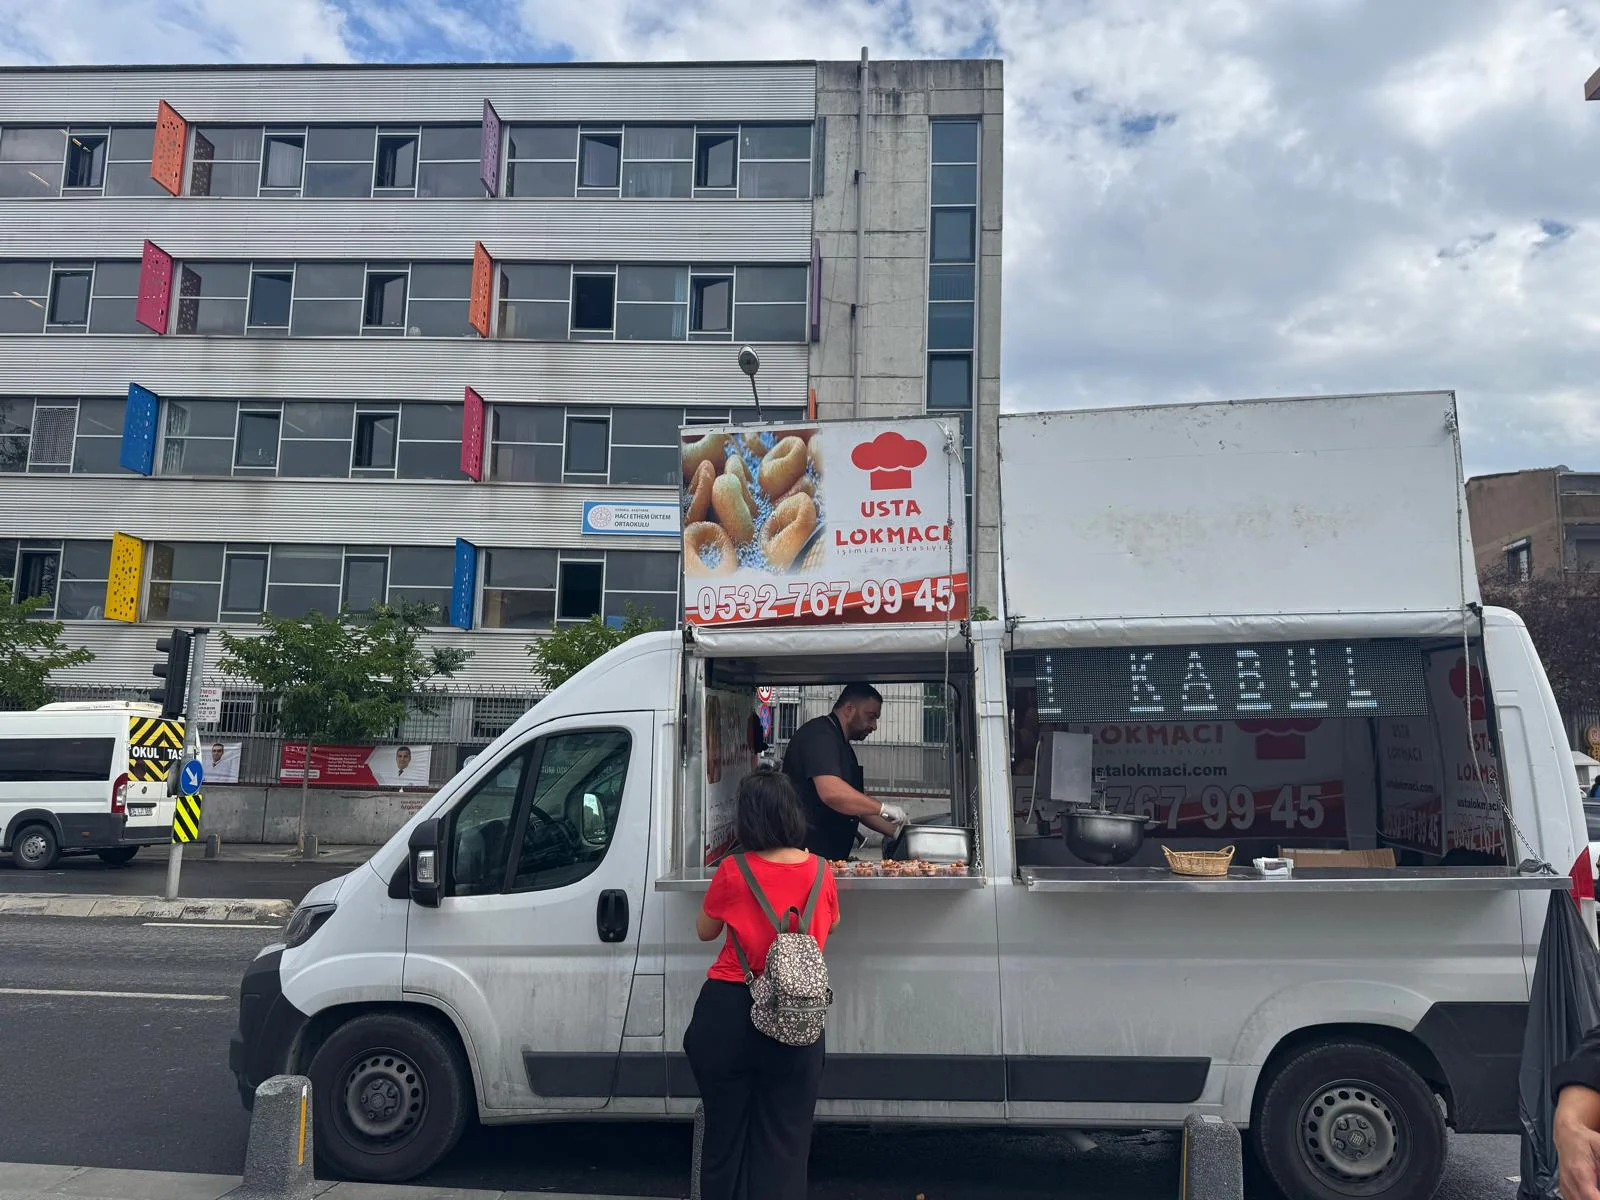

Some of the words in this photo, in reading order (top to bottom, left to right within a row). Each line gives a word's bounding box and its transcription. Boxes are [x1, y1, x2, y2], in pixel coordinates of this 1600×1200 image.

[860, 499, 922, 518] USTA
[835, 525, 950, 546] LOKMACI
[697, 584, 778, 621] 0532
[788, 580, 851, 617] 767
[860, 578, 903, 616] 99
[913, 576, 956, 613] 45
[1129, 647, 1376, 706] KABUL
[132, 746, 159, 759] OKUL
[1109, 784, 1187, 830] 767
[1199, 784, 1256, 831] 99
[1269, 784, 1326, 830] 45
